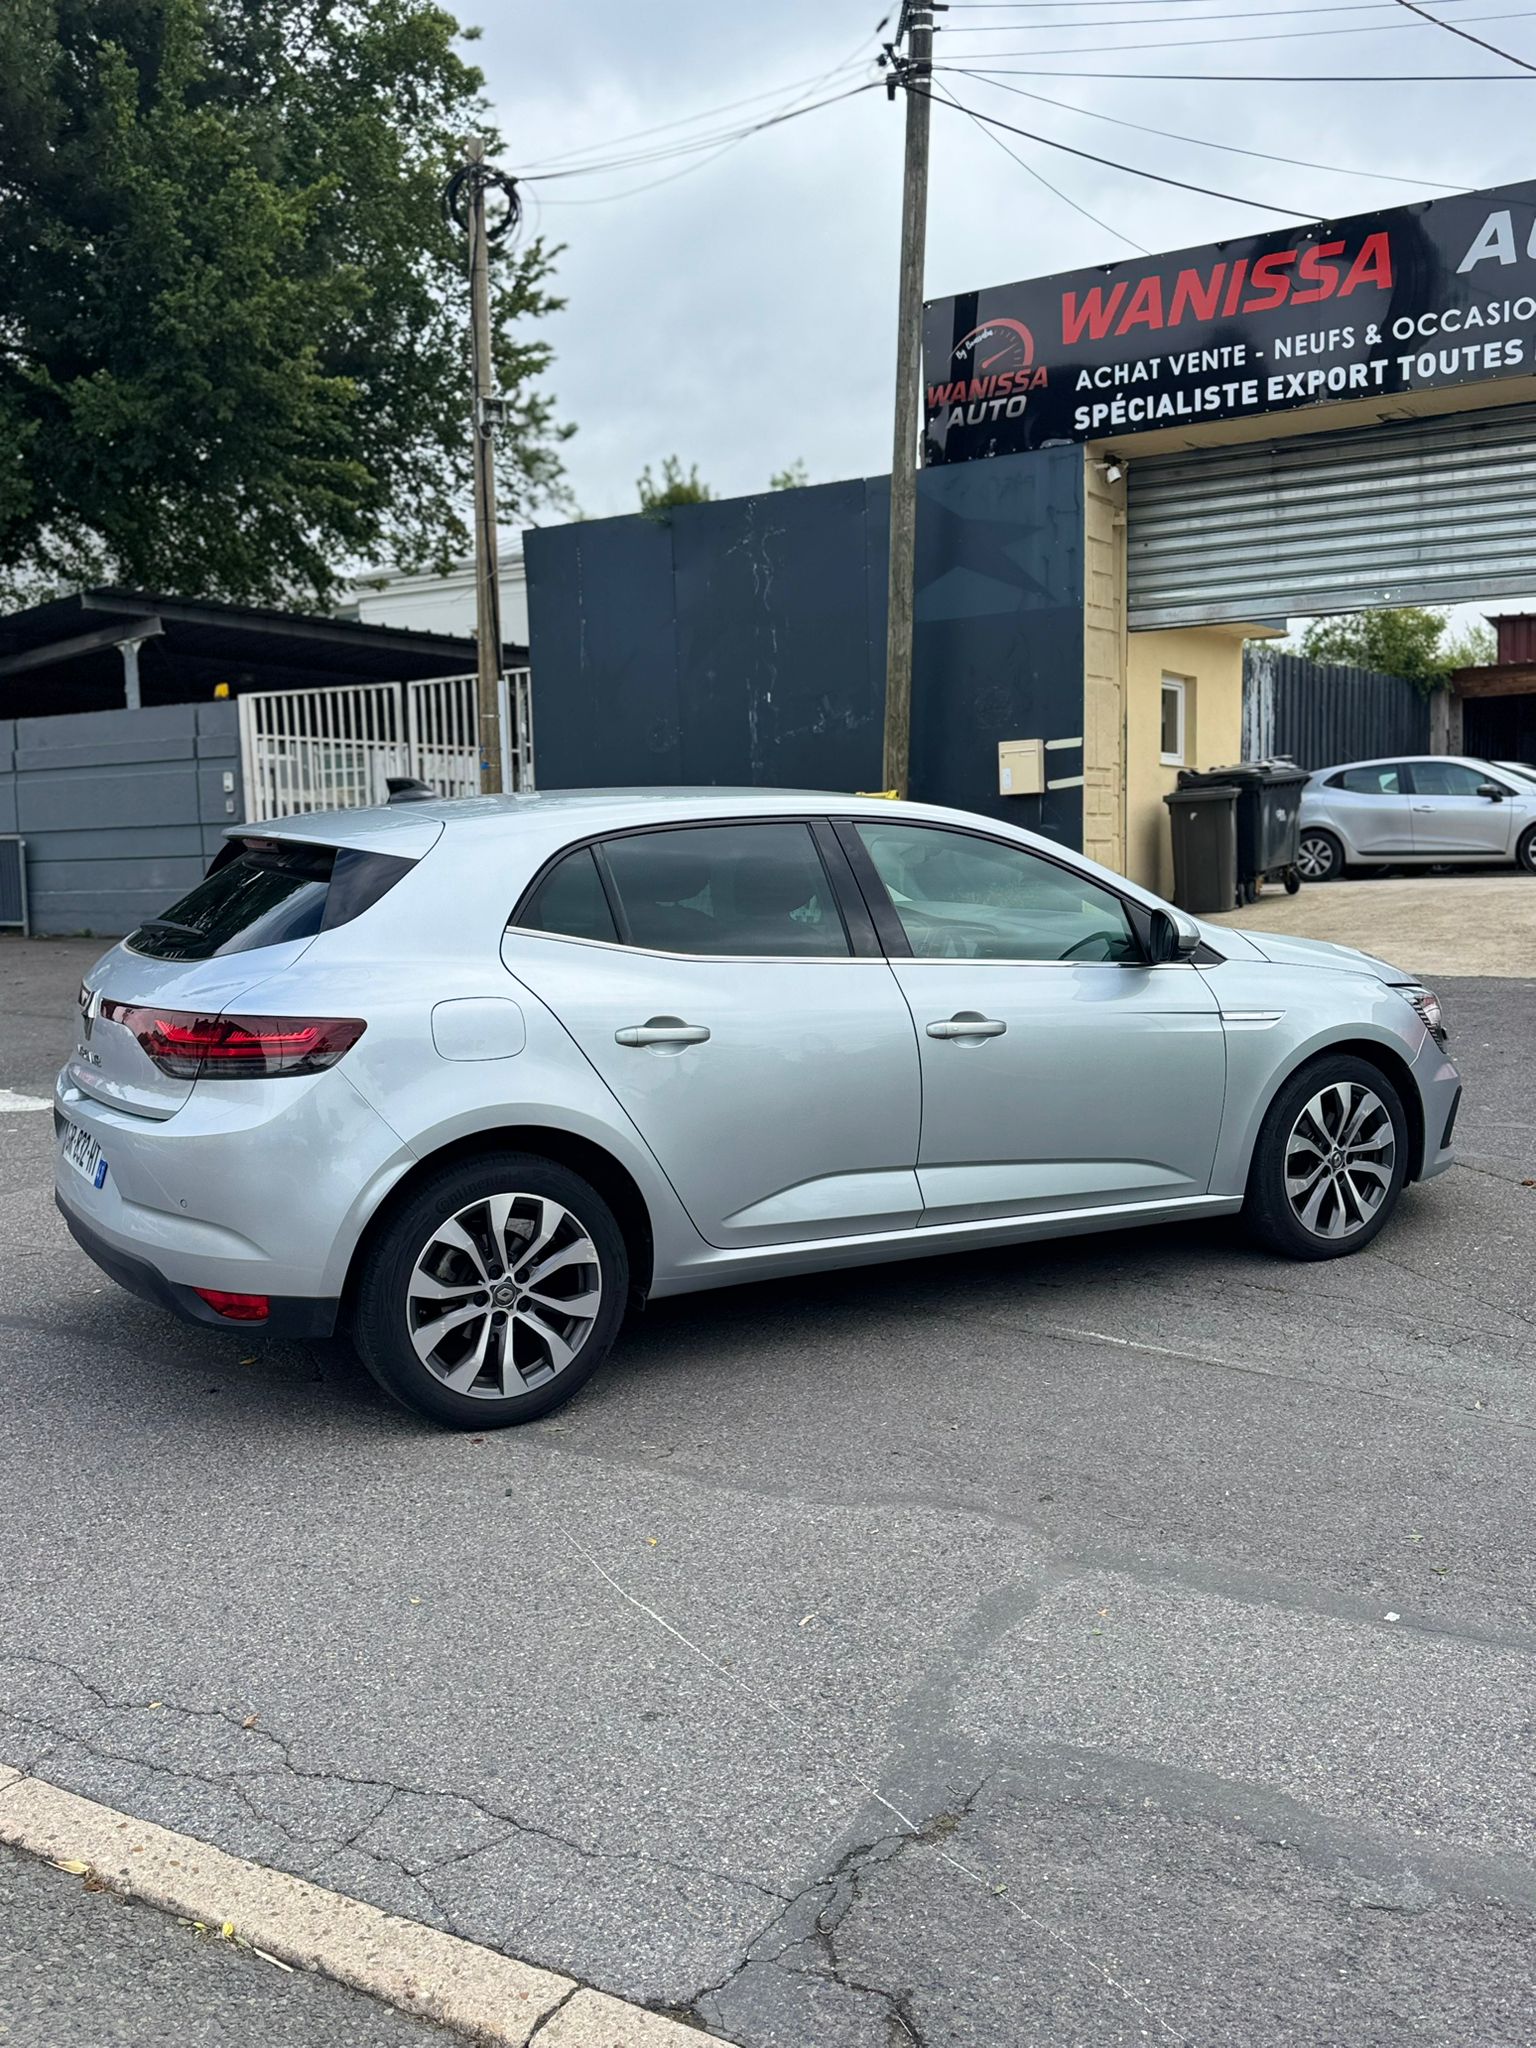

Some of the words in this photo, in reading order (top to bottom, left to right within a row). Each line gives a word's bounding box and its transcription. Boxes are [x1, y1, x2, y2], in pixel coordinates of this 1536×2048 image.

[1456, 209, 1536, 274] A
[1062, 231, 1393, 345] WANISSA
[1075, 357, 1162, 391] ACHAT
[1168, 344, 1246, 376] VENTE
[1274, 326, 1355, 360] NEUFS
[1365, 323, 1382, 346] &
[1392, 296, 1536, 341] OCCASIO
[927, 366, 1048, 409] WANISSA
[945, 395, 1027, 429] AUTO
[1073, 379, 1259, 431] SPÉCIALISTE
[1267, 359, 1389, 401] EXPORT
[1397, 338, 1524, 381] TOUTES
